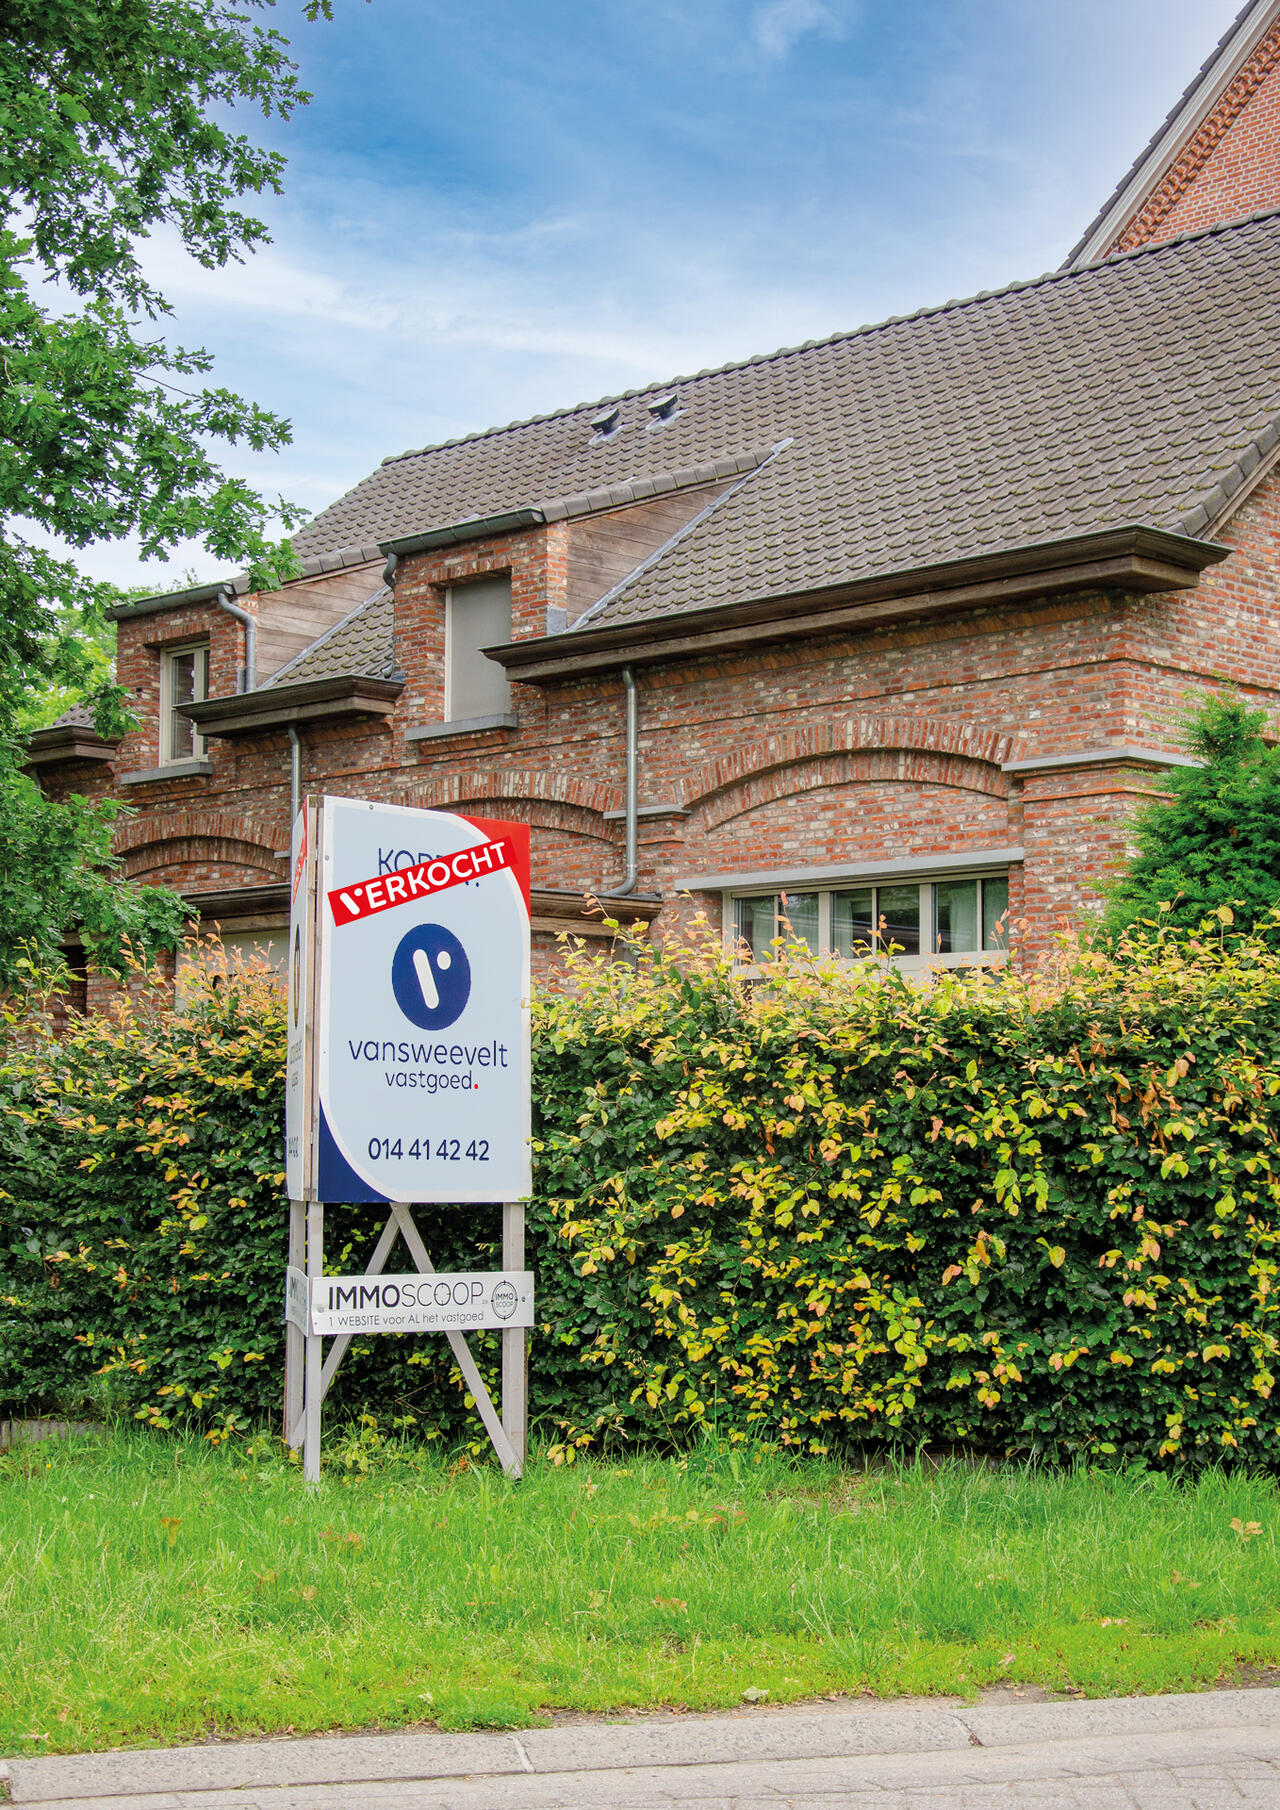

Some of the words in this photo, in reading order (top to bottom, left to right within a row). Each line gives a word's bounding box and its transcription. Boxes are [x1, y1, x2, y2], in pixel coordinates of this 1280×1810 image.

[348, 1040, 508, 1068] vansweevelt
[368, 1137, 404, 1160] 014
[408, 1138, 430, 1160] 41
[436, 1139, 461, 1161] 42
[465, 1139, 490, 1161] 42
[495, 1292, 514, 1301] IMMO
[328, 1316, 334, 1327] 1
[337, 1315, 380, 1326] WEBSITE
[382, 1316, 406, 1325] voor
[408, 1314, 420, 1324] AL
[422, 1312, 438, 1324] het
[441, 1311, 485, 1325] vastgoed
